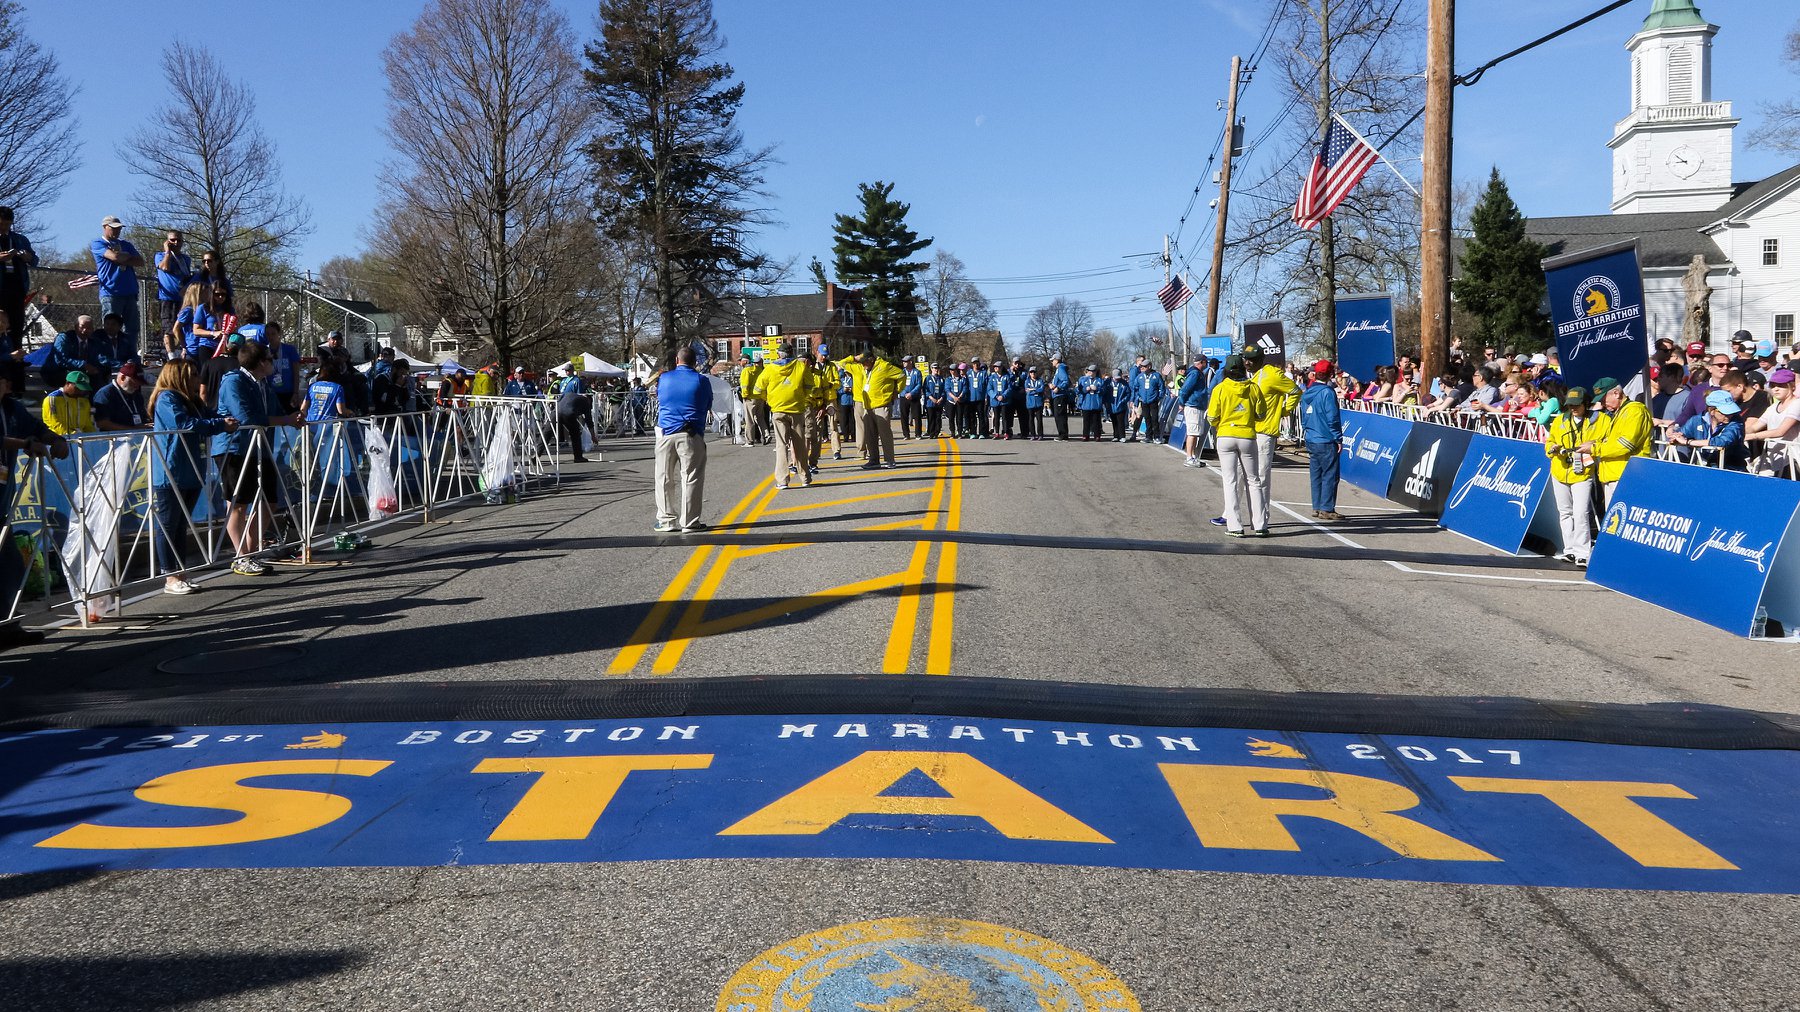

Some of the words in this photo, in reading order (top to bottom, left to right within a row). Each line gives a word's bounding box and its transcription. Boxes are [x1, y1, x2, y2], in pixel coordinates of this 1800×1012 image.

[1579, 277, 1600, 296] ATHLETIC
[1599, 277, 1620, 308] ASSOCIATION
[1338, 320, 1359, 339] John
[1358, 319, 1392, 334] Hancock
[1558, 319, 1592, 335] BOSTON
[1593, 306, 1640, 326] MARATHON
[1263, 344, 1282, 355] das
[1568, 332, 1594, 361] John
[1592, 322, 1635, 344] Hancock
[1405, 476, 1434, 501] adidas
[1449, 452, 1497, 509] John
[1487, 455, 1542, 519] Hancock
[1628, 505, 1649, 524] THE
[1647, 509, 1693, 534] BOSTON
[1621, 523, 1686, 555] MARATHON
[1690, 526, 1727, 562] John
[1722, 530, 1773, 573] Hancock
[398, 726, 700, 745] BOSTON
[777, 719, 1201, 751] MARATHON
[1345, 743, 1522, 765] 2017
[34, 750, 1738, 871] START
